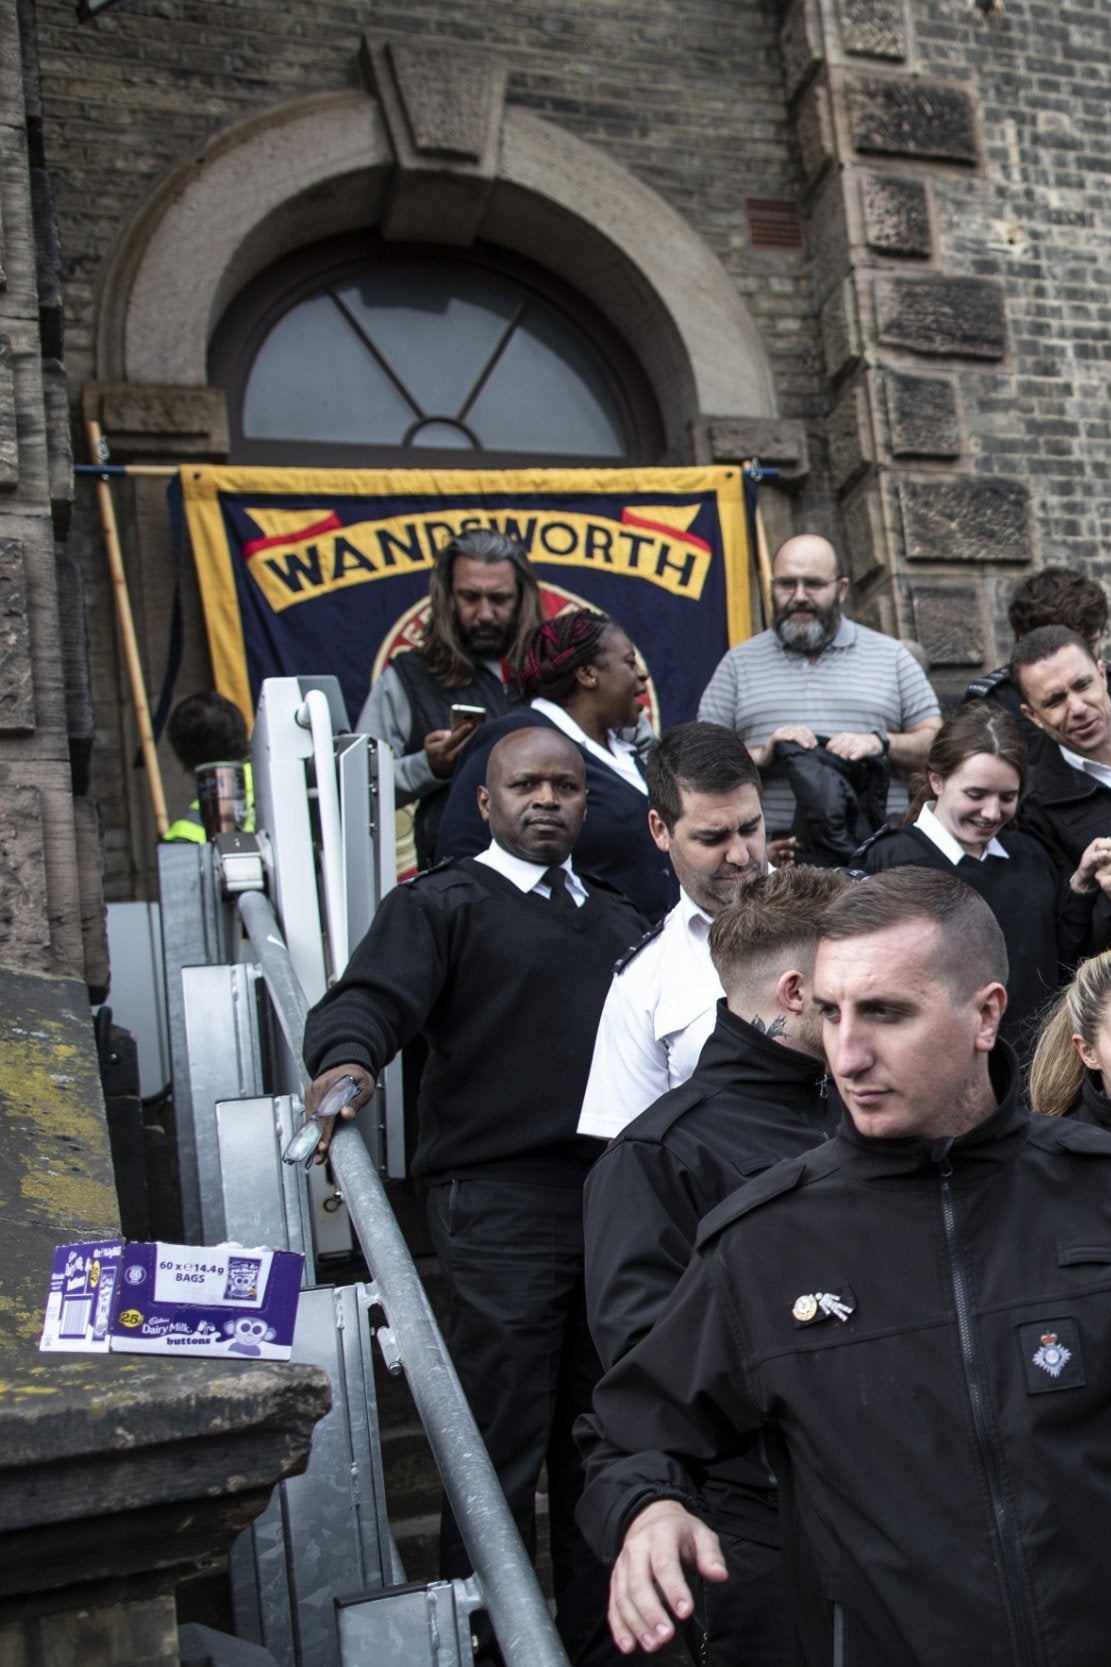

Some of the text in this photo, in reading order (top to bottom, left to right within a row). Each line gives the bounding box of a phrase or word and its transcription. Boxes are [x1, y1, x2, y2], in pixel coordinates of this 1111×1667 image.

[160, 1261, 173, 1270] 60
[176, 1273, 205, 1283] BAGS
[142, 1322, 190, 1336] Dairy Milk
